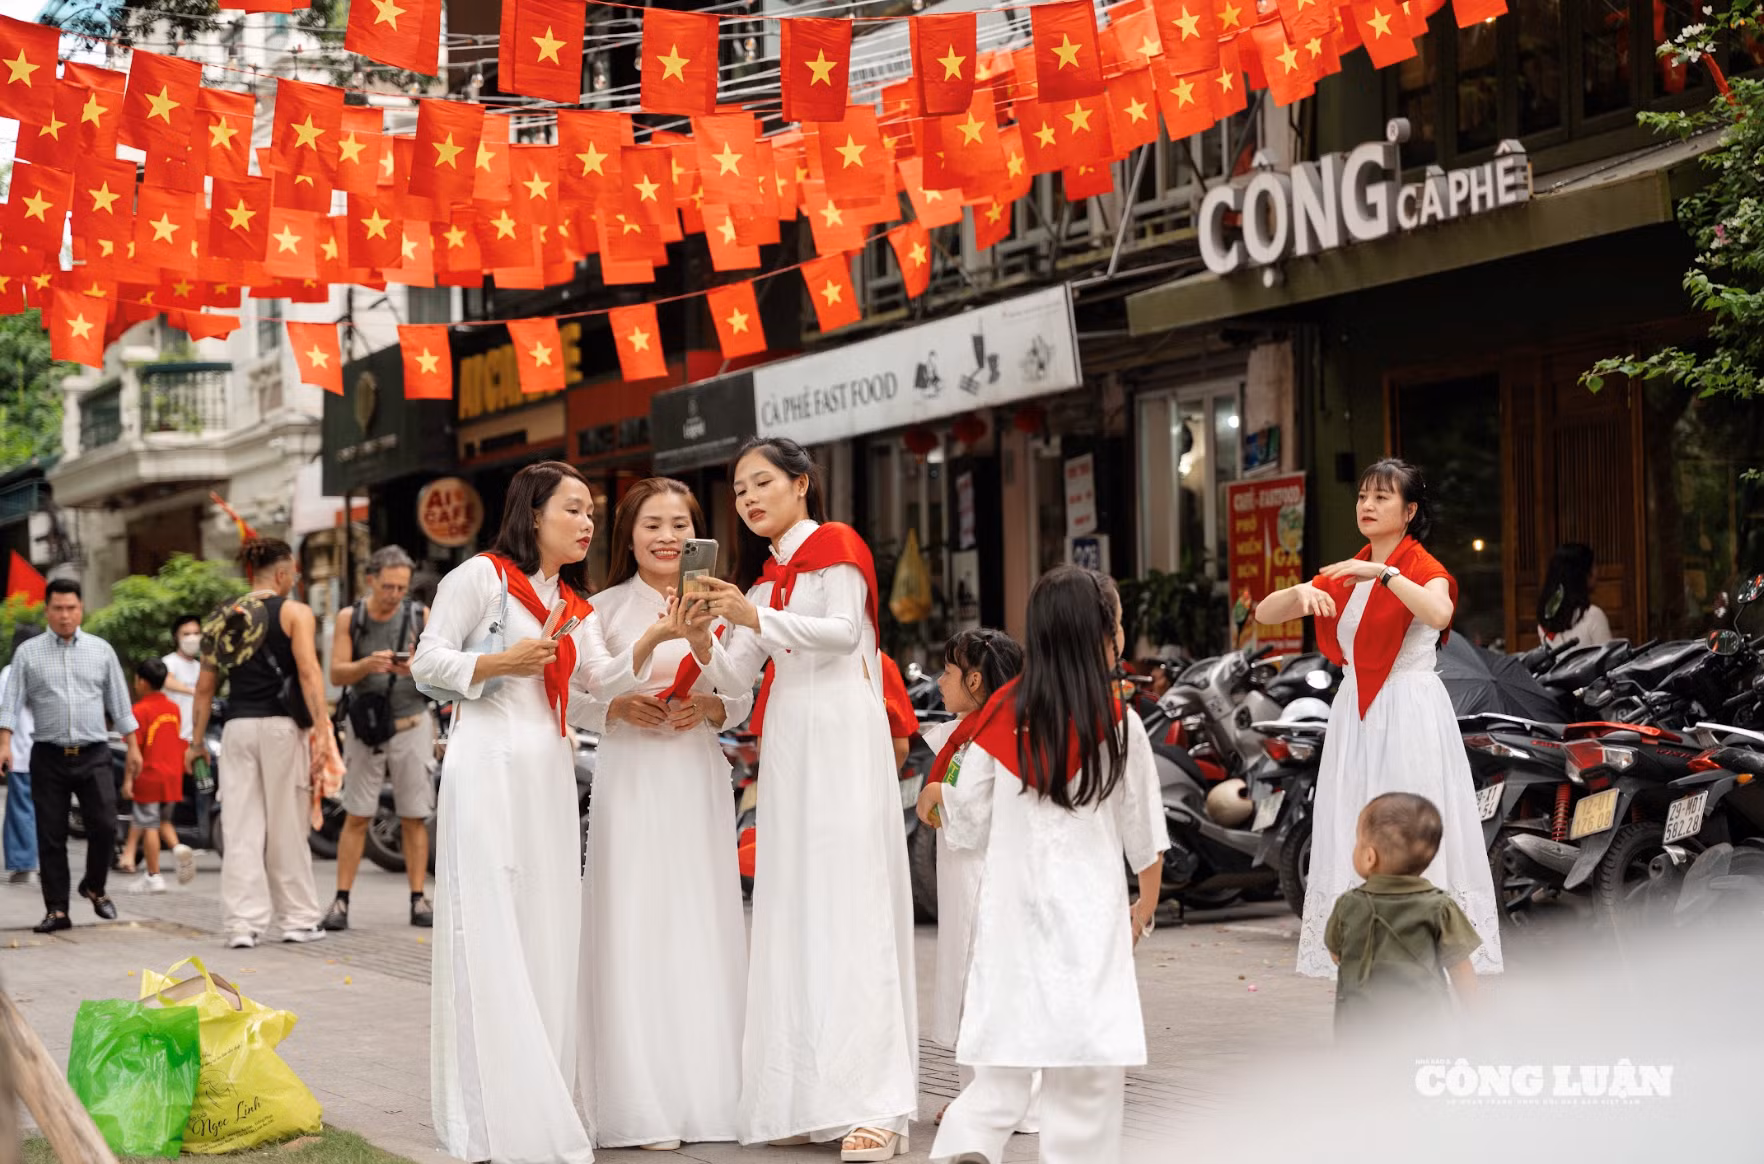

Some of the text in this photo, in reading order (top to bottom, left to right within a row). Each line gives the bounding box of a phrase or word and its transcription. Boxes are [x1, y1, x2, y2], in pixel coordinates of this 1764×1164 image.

[1199, 142, 1399, 288] CỘNG
[851, 371, 898, 408] FOOD
[1665, 814, 1700, 841] 582.28
[235, 1096, 261, 1122] Linh
